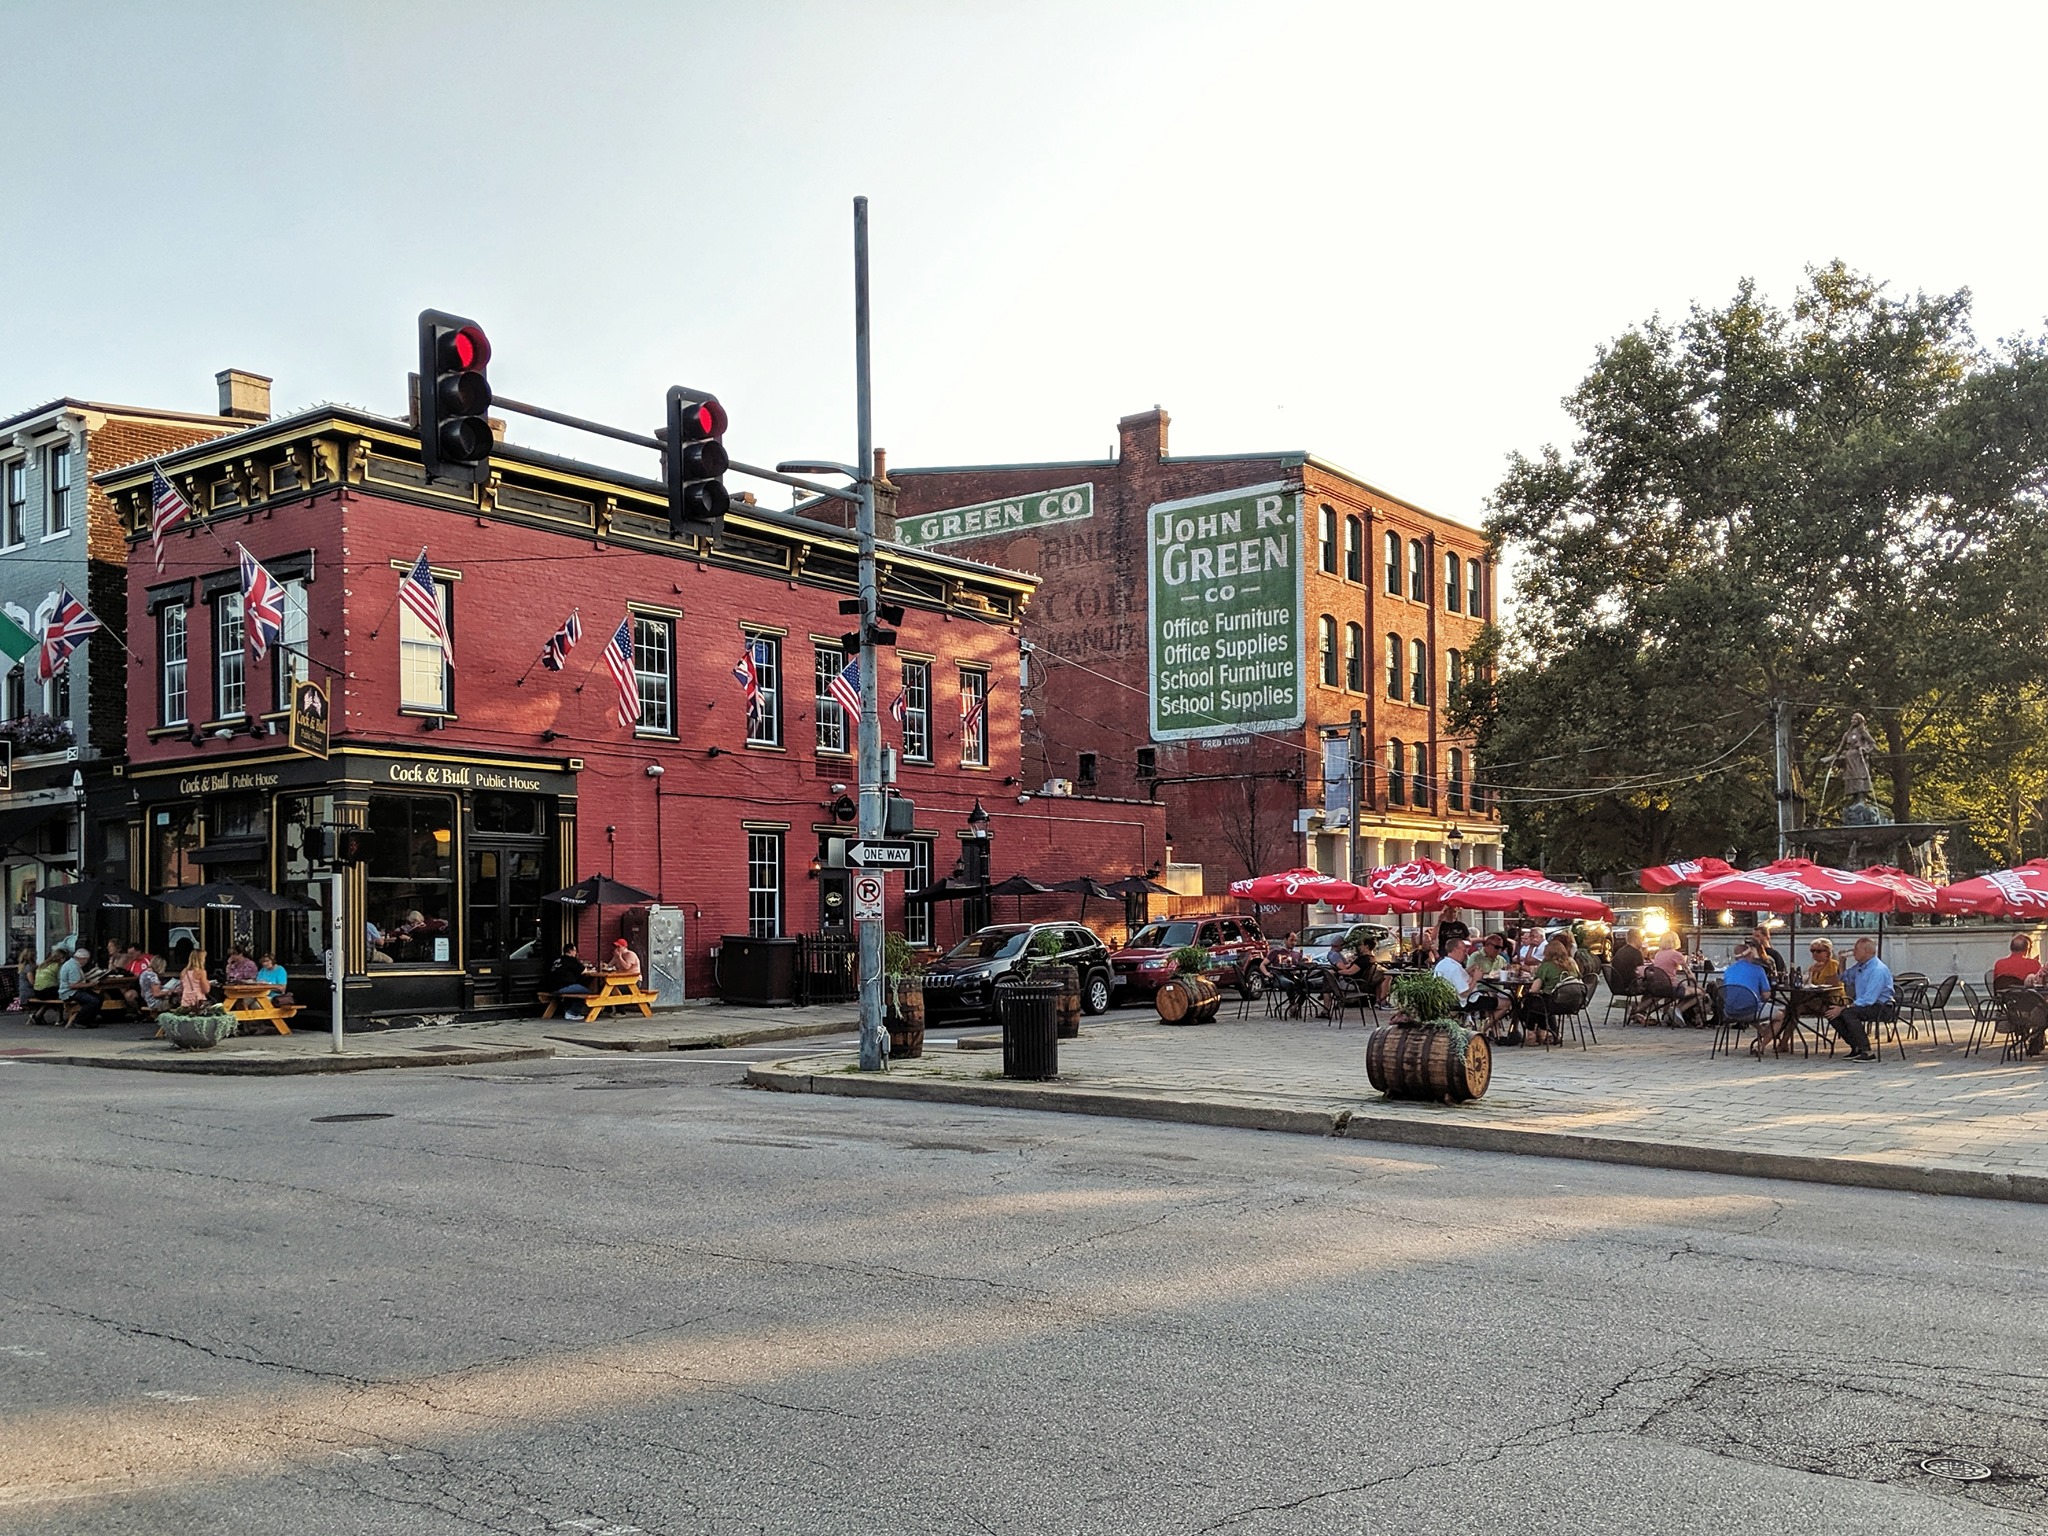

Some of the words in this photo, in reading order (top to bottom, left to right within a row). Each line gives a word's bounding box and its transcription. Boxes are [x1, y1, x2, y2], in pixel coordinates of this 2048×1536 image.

[921, 502, 1025, 540] GREEN
[1039, 492, 1084, 520] CO
[1156, 509, 1242, 545] JOHN
[1256, 495, 1296, 529] R.
[1163, 534, 1289, 586] GREEN
[1163, 618, 1209, 640] Office
[1215, 608, 1290, 633] Furniture
[1164, 643, 1211, 665] Office
[1215, 633, 1288, 661] Supplies
[1160, 666, 1214, 691] School
[1220, 660, 1294, 685] Furniture
[1161, 691, 1215, 717] School
[1220, 685, 1294, 713] Supplies
[1202, 740, 1222, 749] FRED
[1224, 737, 1250, 747] LEMON
[180, 775, 201, 794] Cock
[201, 776, 211, 792] &
[211, 771, 230, 791] Bull
[232, 774, 254, 788] Public
[255, 773, 279, 786] House
[389, 763, 424, 782] Cock
[425, 767, 439, 784] &
[441, 767, 471, 785] Bull
[475, 773, 507, 788] Public
[509, 776, 540, 791] House
[863, 848, 884, 860] ONE
[886, 849, 908, 860] WAY
